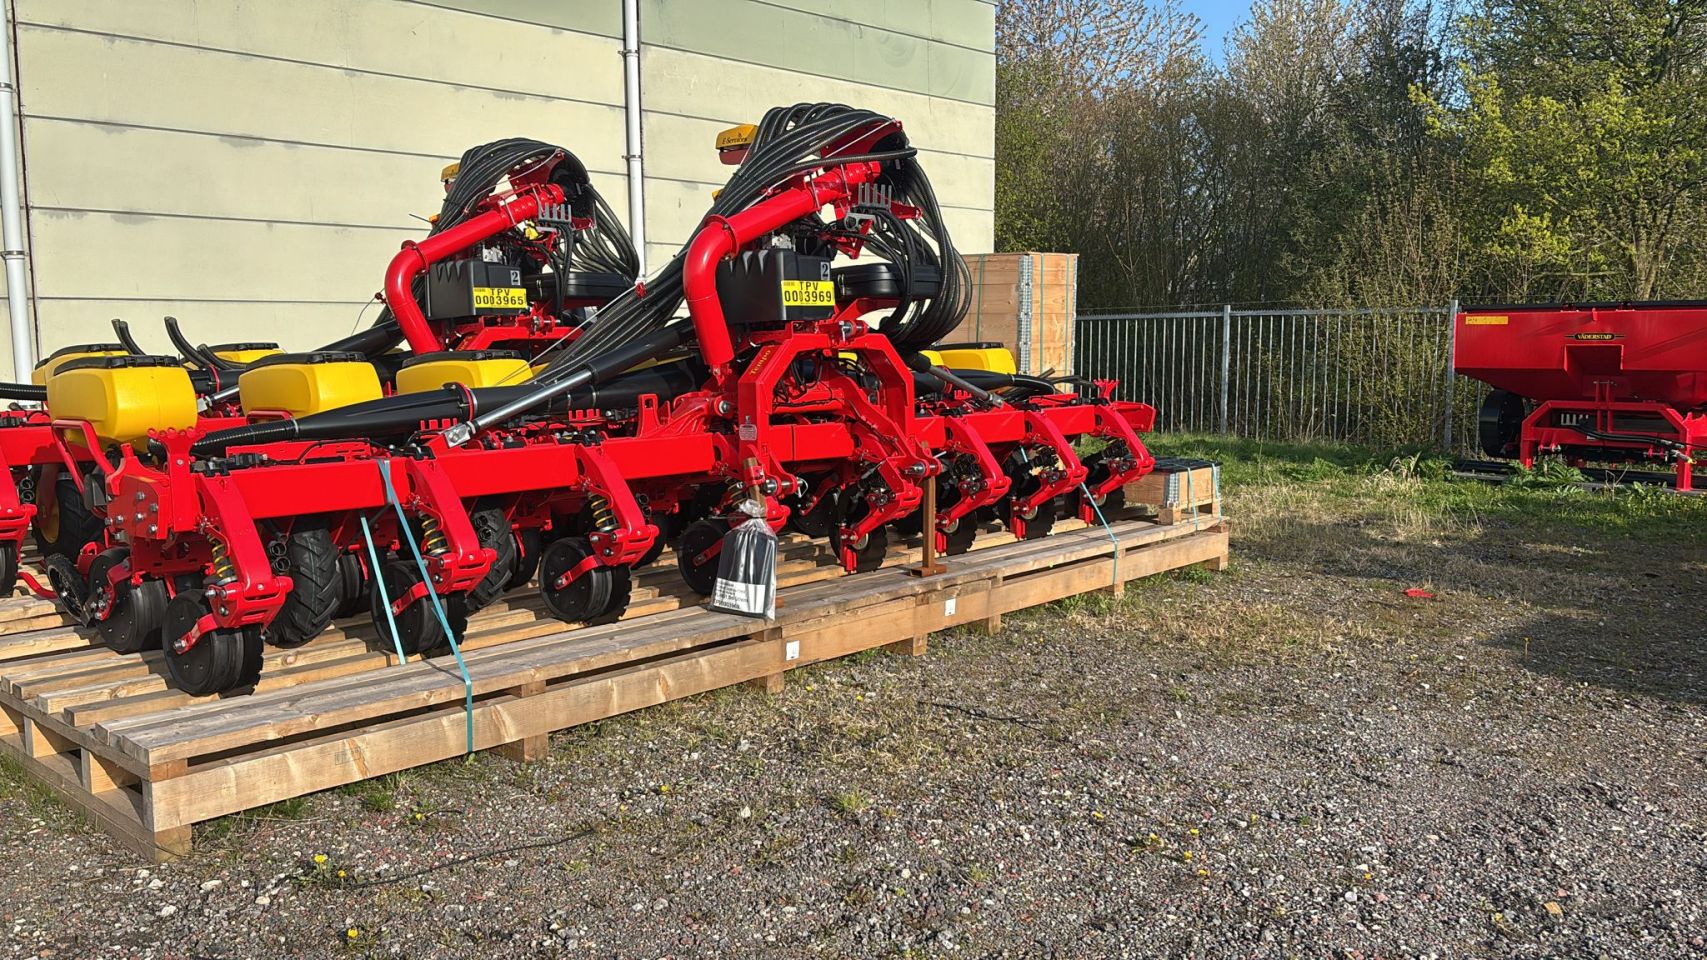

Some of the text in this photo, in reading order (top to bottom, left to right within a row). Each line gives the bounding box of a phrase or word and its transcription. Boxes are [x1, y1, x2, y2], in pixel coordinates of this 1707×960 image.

[822, 263, 829, 278] 2
[511, 271, 519, 283] 2
[490, 288, 510, 296] TPV
[800, 281, 819, 291] TPV
[475, 295, 524, 306] 0003965
[784, 290, 832, 303] 0003969
[750, 350, 771, 376] Tempo
